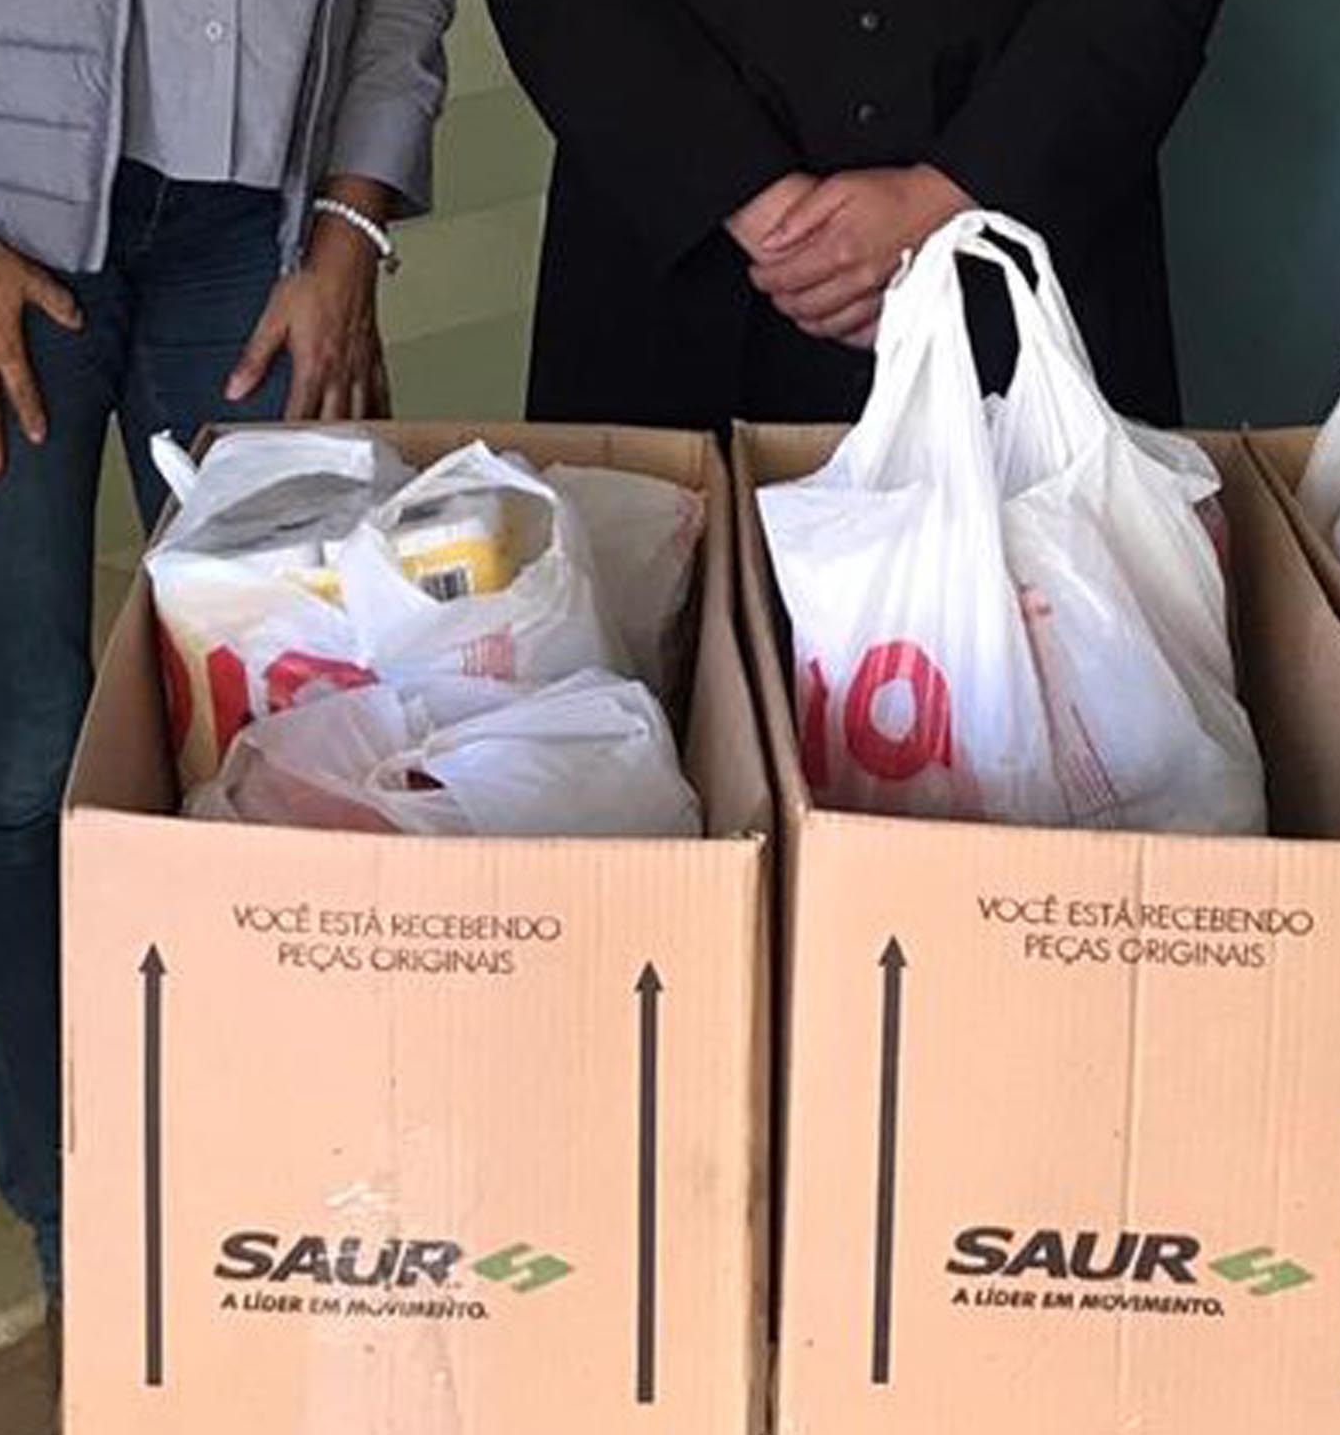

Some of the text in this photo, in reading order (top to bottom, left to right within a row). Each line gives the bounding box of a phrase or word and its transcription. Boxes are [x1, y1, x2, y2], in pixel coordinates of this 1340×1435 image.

[233, 903, 561, 940] VOCÊ ESTÁ RECEBENDO
[978, 894, 1314, 936] VOCÊ ESTÁ RECEBENDO
[278, 942, 515, 975] PEÇAS ORIGINAIS
[1025, 933, 1265, 967] PEÇAS ORIGINAIS
[214, 1232, 464, 1288] SAUR
[945, 1226, 1200, 1284] SAUR
[220, 1292, 238, 1310] A
[242, 1289, 304, 1313] LÍDER
[310, 1297, 341, 1315] EM
[952, 1288, 969, 1304] A
[975, 1282, 1036, 1308] LÍDER
[1042, 1291, 1074, 1309] EM
